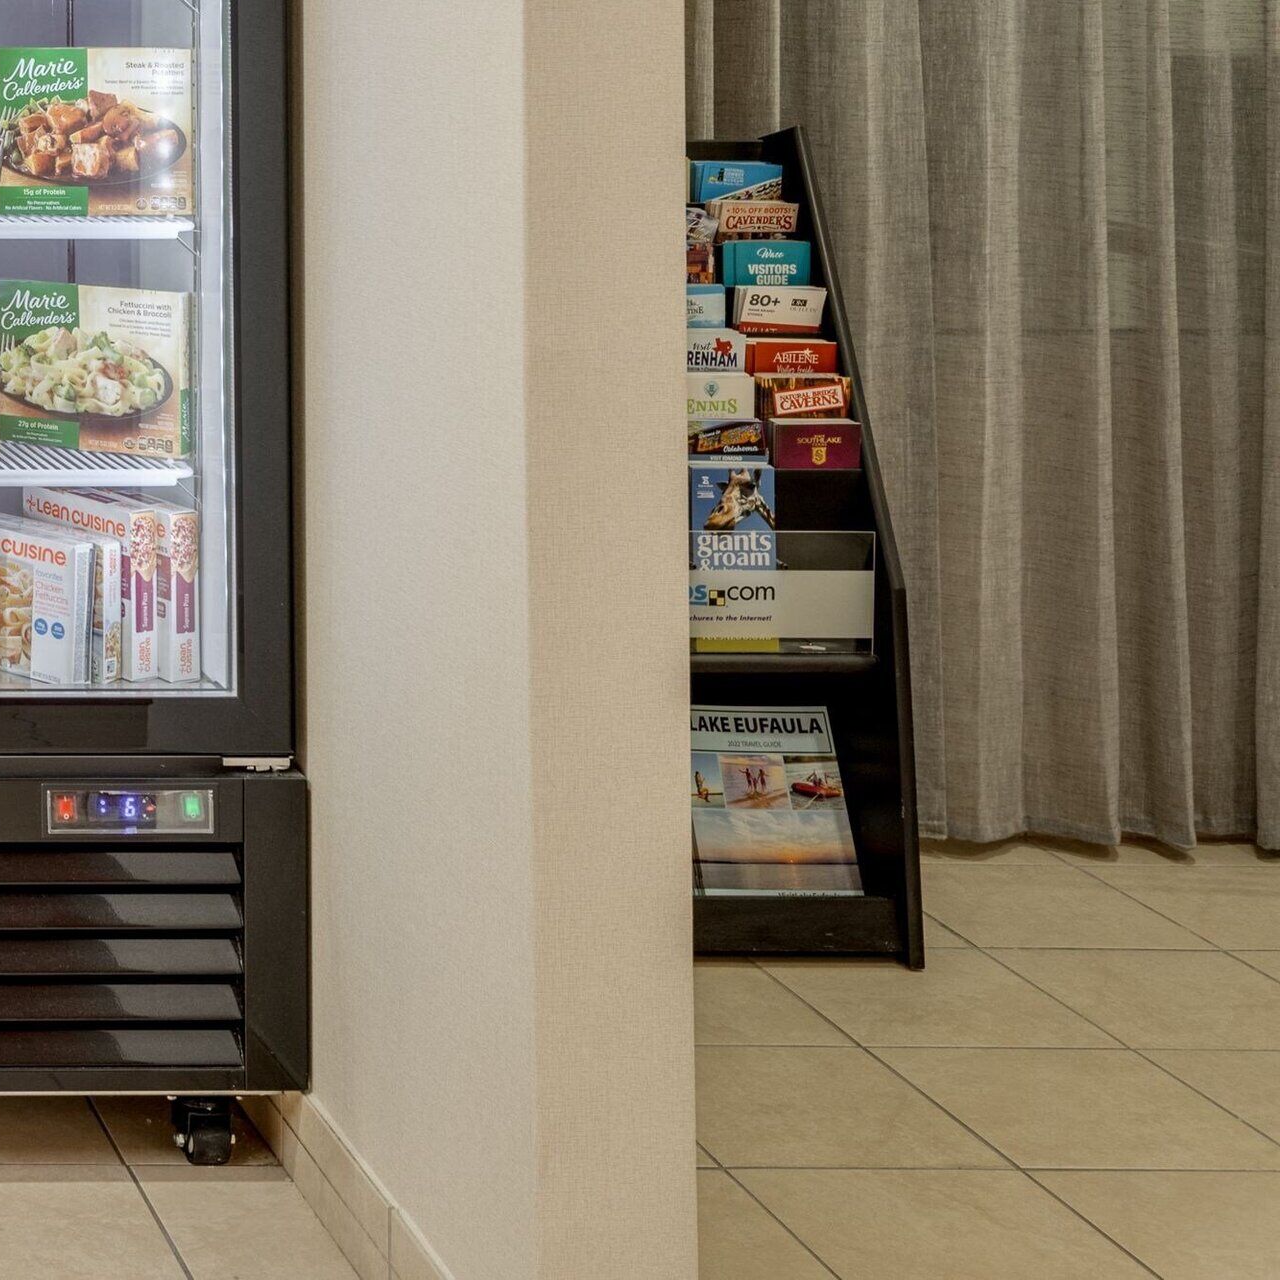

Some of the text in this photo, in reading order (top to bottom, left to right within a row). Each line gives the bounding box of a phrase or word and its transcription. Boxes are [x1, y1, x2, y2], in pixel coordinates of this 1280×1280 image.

[3, 58, 77, 83] Marie
[3, 77, 82, 101] Callender's
[43, 188, 66, 196] Protein
[726, 215, 792, 230] CAVENDER'S
[756, 248, 784, 258] Waco
[748, 264, 797, 275] VISITORS
[756, 275, 788, 285] GUIDE
[1, 290, 70, 312] Marie
[120, 301, 172, 311] Fettuccini with
[749, 294, 780, 307] 80+
[107, 308, 135, 316] Chicken
[143, 310, 172, 318] Broccoli
[1, 311, 74, 329] Callender's
[693, 342, 711, 350] Visit
[773, 352, 818, 364] ABILENE
[780, 388, 838, 402] NATURAL BRIDGE
[688, 398, 737, 414] ENNIS
[780, 395, 839, 411] CAVERNS
[30, 421, 36, 429] of
[37, 422, 59, 431] Protein
[797, 436, 842, 444] SOUTHLAKE
[697, 531, 772, 558] giants
[714, 551, 771, 566] roam
[735, 717, 823, 734] EUFAULA
